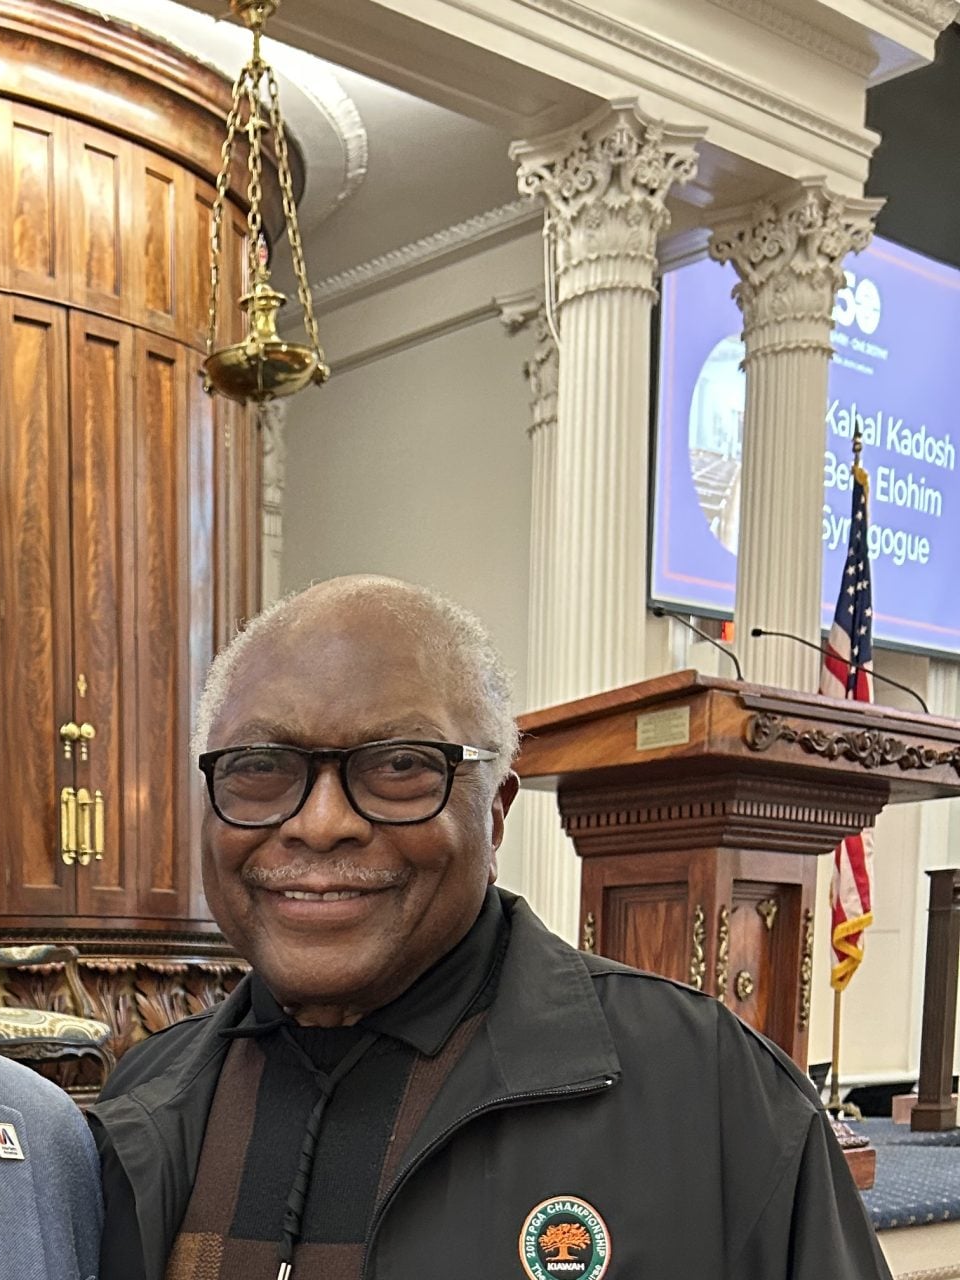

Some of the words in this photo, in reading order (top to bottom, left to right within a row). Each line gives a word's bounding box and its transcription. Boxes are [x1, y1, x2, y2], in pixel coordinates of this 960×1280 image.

[832, 269, 881, 335] 50
[825, 399, 882, 448] Kahal
[886, 416, 955, 471] Kadosh
[876, 465, 943, 517] Elohim
[822, 504, 931, 566] Syngogue
[525, 1235, 535, 1258] 2012
[529, 1212, 547, 1234] PGA
[546, 1201, 606, 1257] CHAMPIONSHIP
[547, 1262, 585, 1271] KIAWAH
